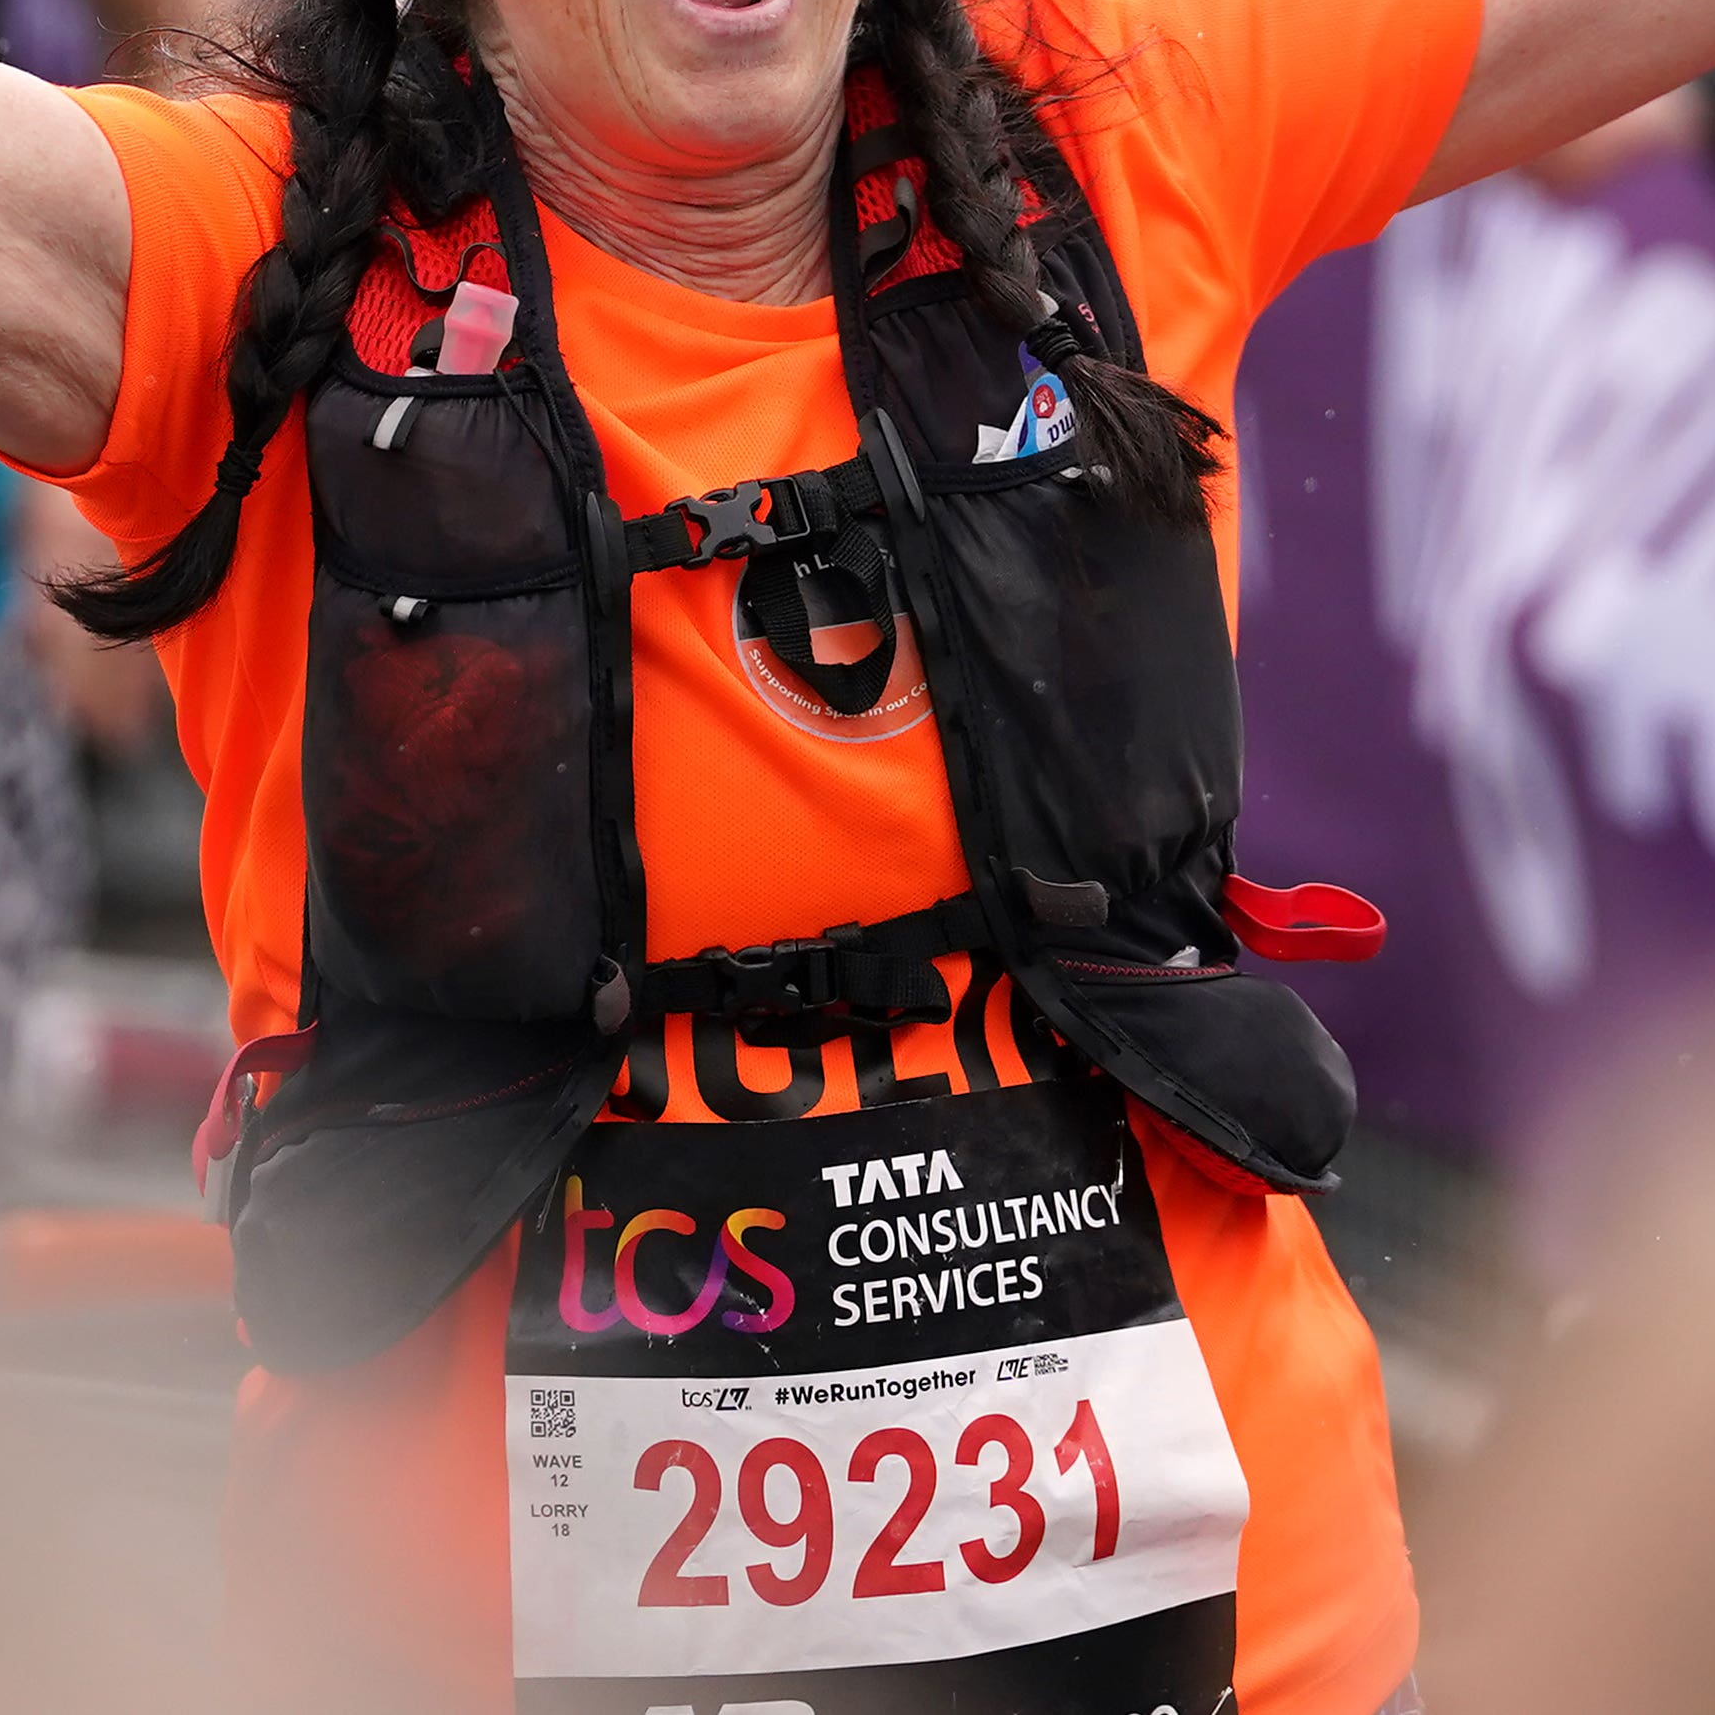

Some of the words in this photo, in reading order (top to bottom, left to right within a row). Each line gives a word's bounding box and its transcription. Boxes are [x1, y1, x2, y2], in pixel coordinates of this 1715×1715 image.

[749, 649, 821, 715] Supporting
[886, 695, 909, 711] our
[822, 1149, 964, 1209] TATA
[828, 1184, 1123, 1266] CONSULTANCY
[558, 1174, 796, 1336] tcs
[832, 1255, 1043, 1328] SERVICES
[682, 1388, 713, 1408] tcs
[775, 1369, 977, 1405] #WeRunTogether
[533, 1455, 583, 1469] WAVE
[550, 1474, 569, 1487] 12
[531, 1504, 589, 1518] LORRY
[632, 1398, 1120, 1609] 29231
[552, 1523, 570, 1536] 18
